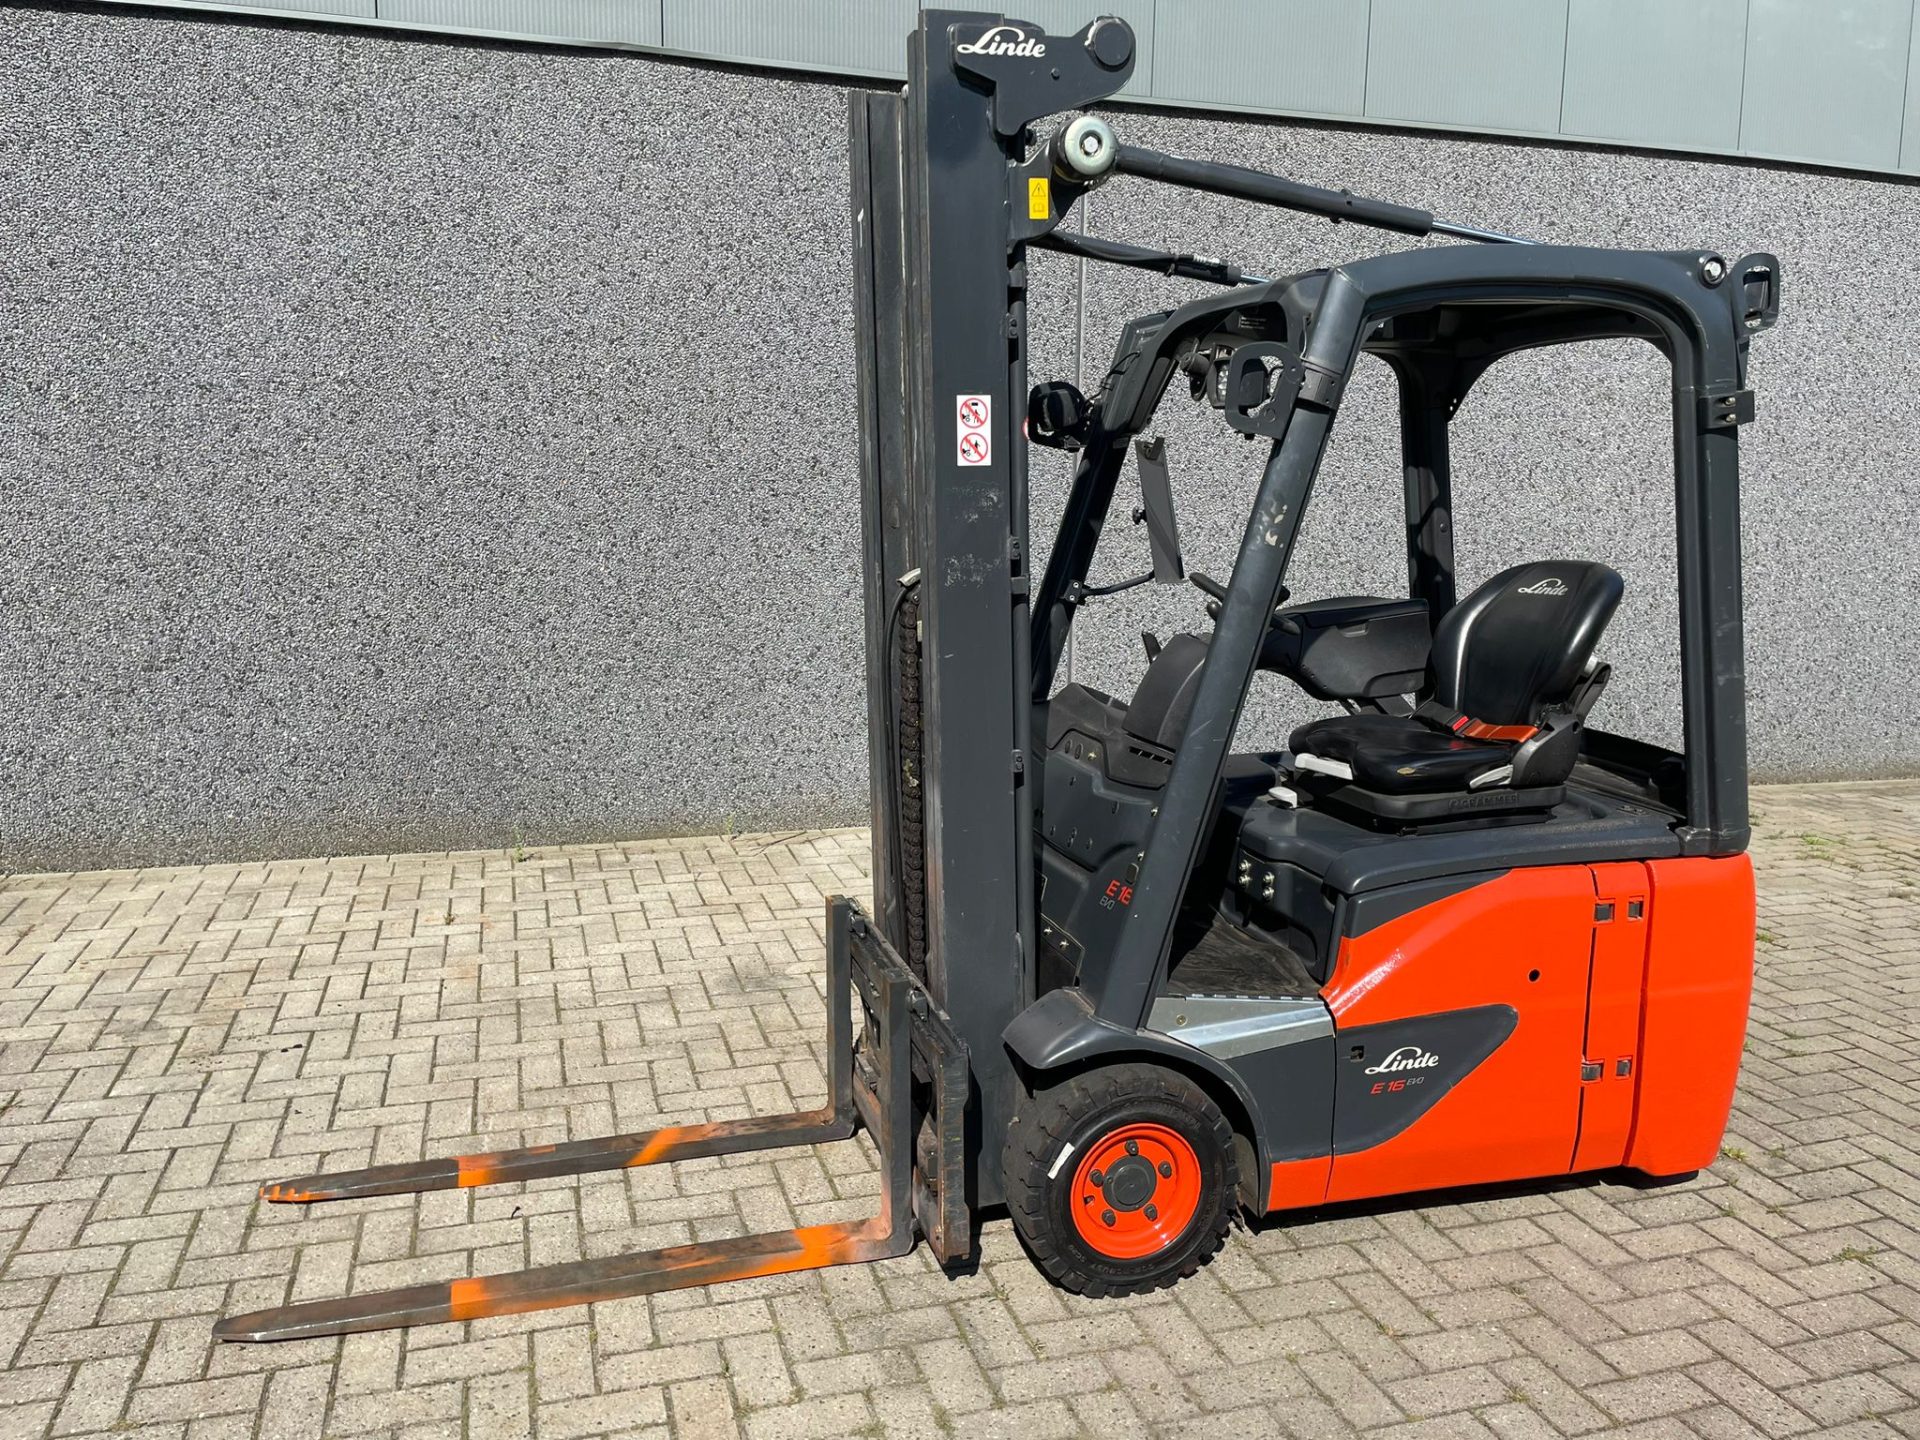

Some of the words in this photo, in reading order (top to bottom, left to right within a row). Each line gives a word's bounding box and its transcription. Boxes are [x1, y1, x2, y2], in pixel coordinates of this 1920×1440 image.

[956, 26, 1046, 58] Linde
[1518, 578, 1568, 595] Linde
[1105, 880, 1120, 896] E
[1100, 896, 1115, 910] EVO
[1364, 1046, 1439, 1075] Linde
[1370, 1082, 1386, 1095] E
[1387, 1079, 1407, 1092] 16
[1406, 1076, 1425, 1086] EVO
